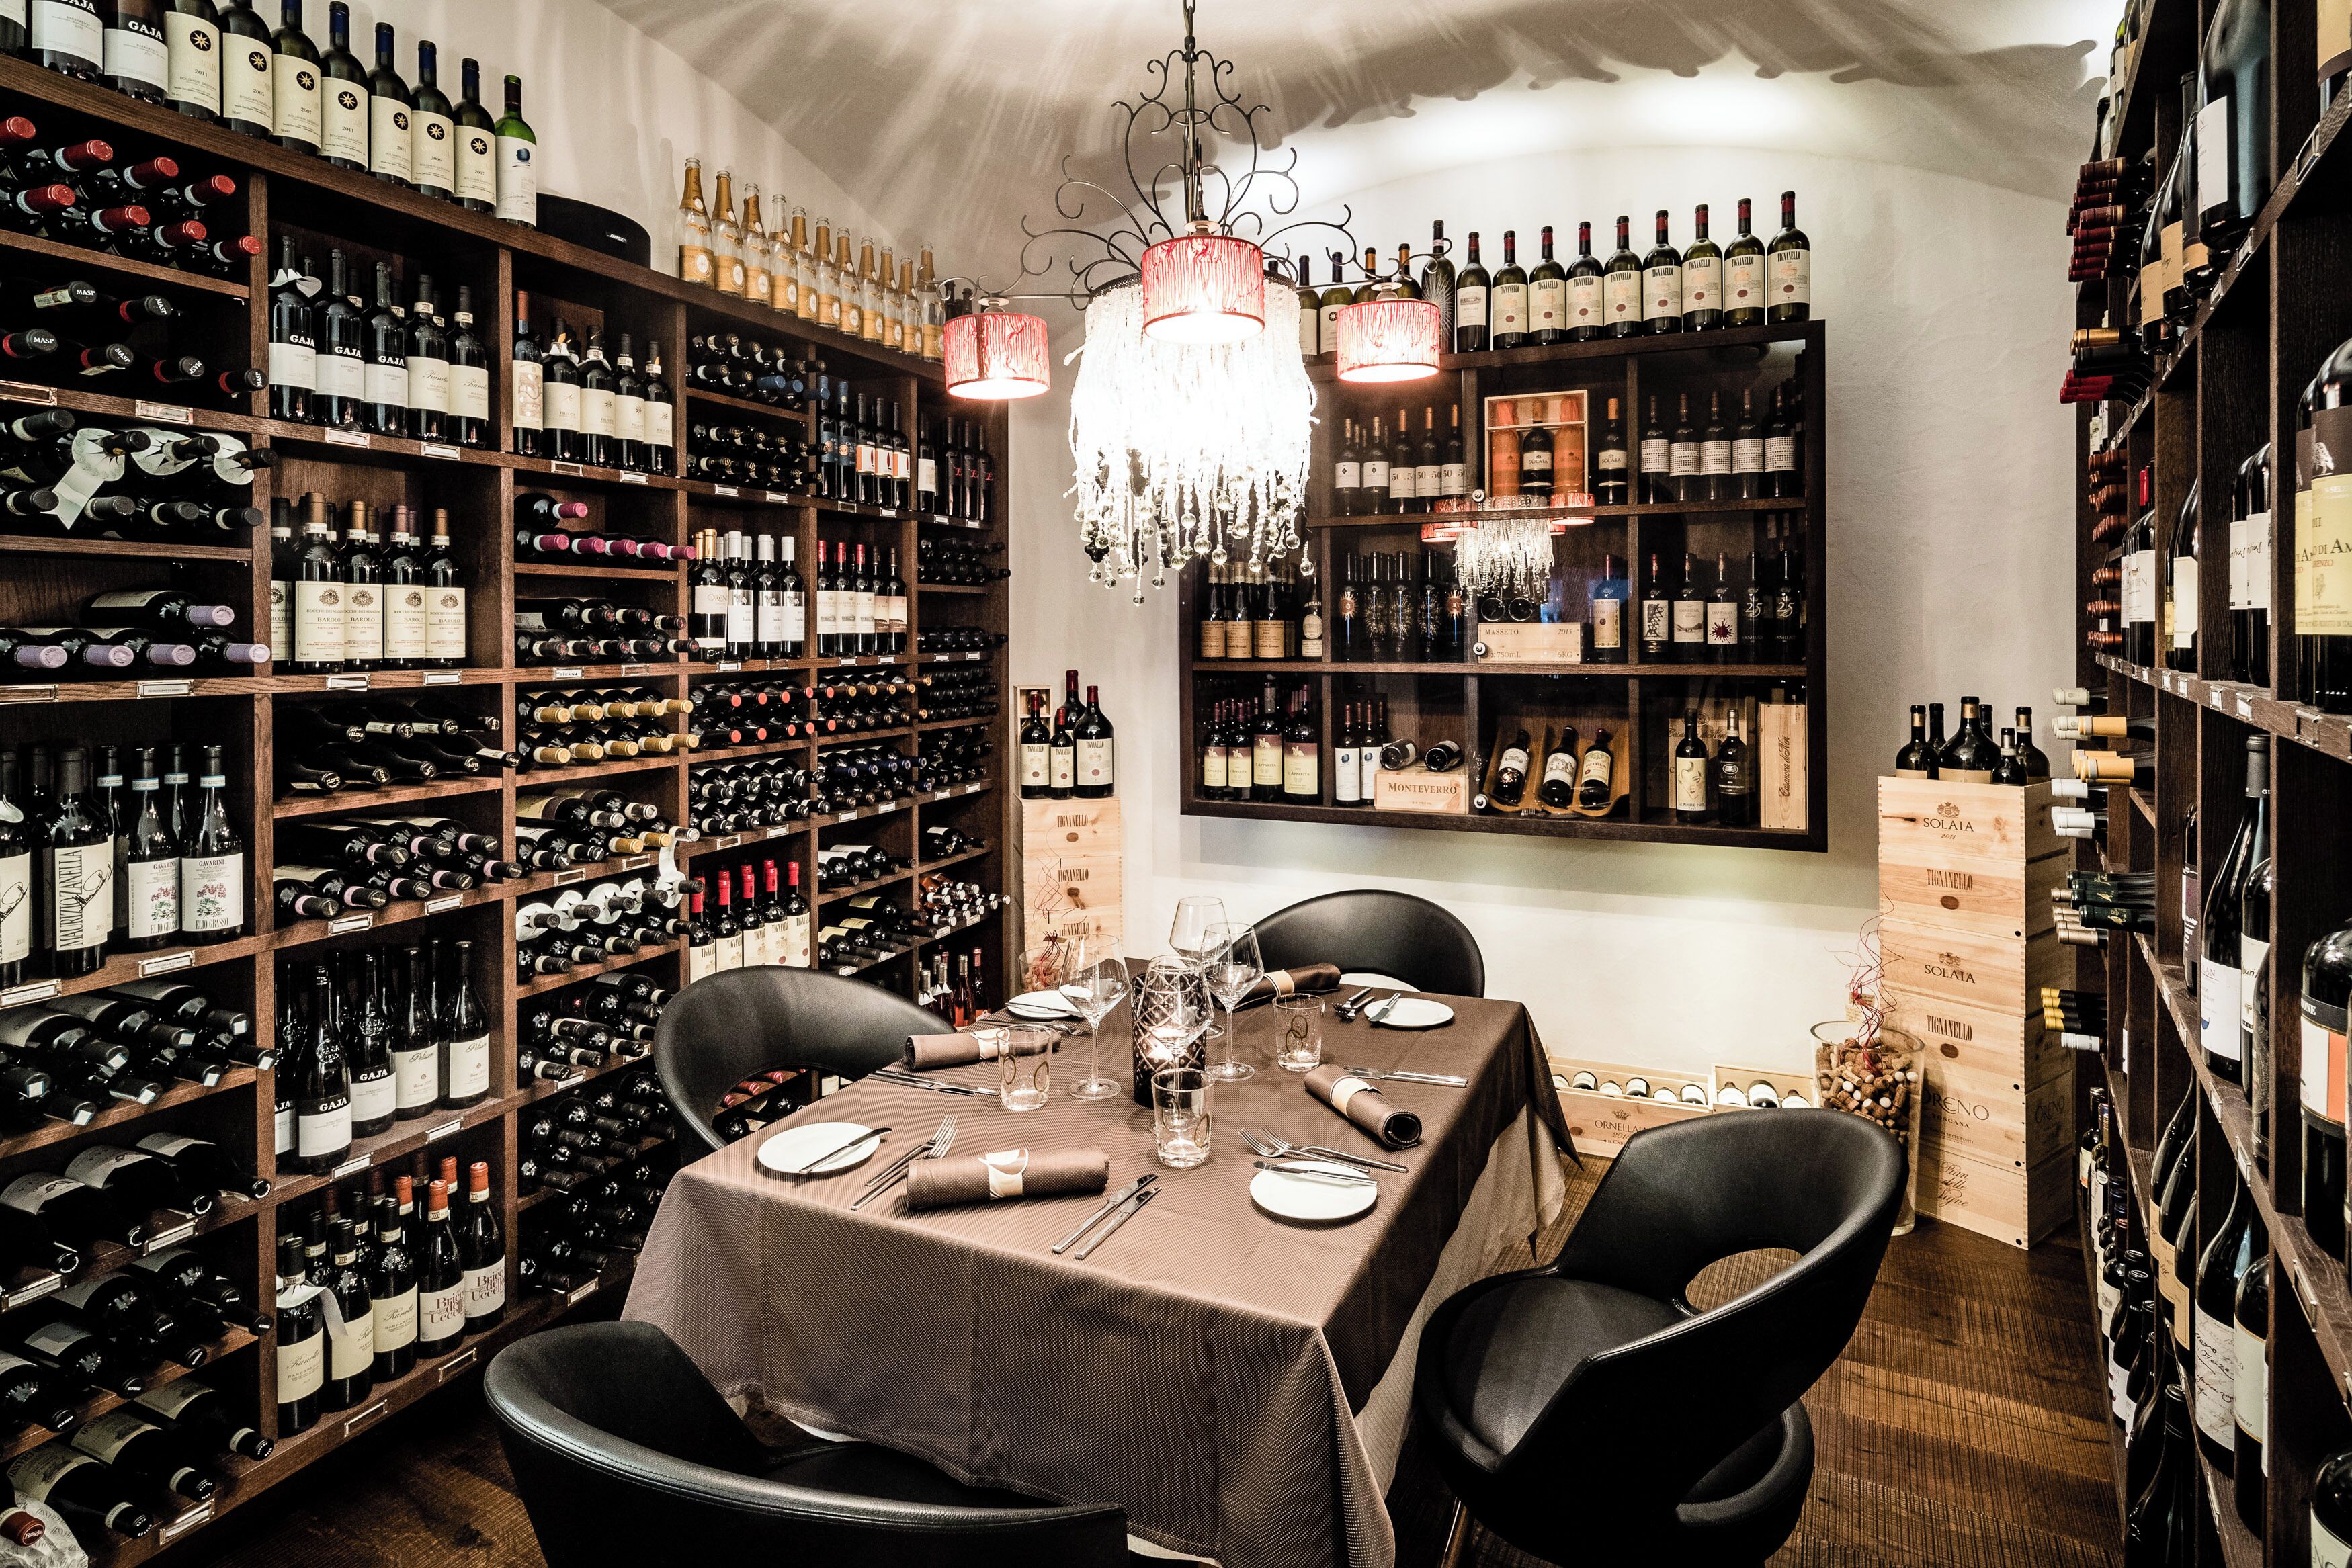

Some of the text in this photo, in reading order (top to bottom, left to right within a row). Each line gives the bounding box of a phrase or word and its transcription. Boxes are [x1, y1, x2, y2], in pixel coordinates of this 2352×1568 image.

[62, 0, 96, 13] AJA
[128, 21, 163, 40] GAJA
[194, 69, 208, 77] 2011
[1732, 257, 1754, 267] TIGNANELLO
[1777, 251, 1801, 262] TIGNANELLO
[1689, 260, 1710, 270] TIGNANELLO
[1611, 273, 1632, 282] TIGNANELLO
[1652, 267, 1673, 277] TIGNANELLO
[1538, 281, 1558, 290] TIGNANELLO
[1574, 277, 1594, 287] TIGNANELLO
[1500, 285, 1520, 294] TIGNANELLO
[290, 335, 315, 347] GAJA
[335, 346, 362, 358] GAJA
[378, 355, 405, 367] GAJA
[1417, 471, 1426, 479] 50
[1443, 470, 1452, 478] 50
[2330, 539, 2352, 554] AM
[1745, 602, 1763, 617] 25
[1777, 601, 1795, 617] 25
[1778, 765, 1790, 798] Casanova
[1388, 782, 1457, 795] MONTEVERRO
[1057, 815, 1088, 828] TIGNANELLO
[1923, 818, 1974, 832] SOLAIA
[199, 859, 225, 867] GAVARINI
[1058, 868, 1089, 882] TIGNANELLO
[1926, 869, 1973, 891] TIGNANELLO
[150, 923, 163, 934] ELIO
[196, 917, 228, 930] ELIO GRASSO
[1925, 964, 1976, 984] SOLAIA
[1927, 1015, 1972, 1042] TIGNANELLO
[360, 1068, 388, 1081] GAJA
[274, 1100, 290, 1113] AJA
[319, 1097, 348, 1112] GAJA
[1923, 1088, 1990, 1121] ORENO
[1932, 1114, 1970, 1129] TOSCANA
[1939, 1158, 1968, 1179] Pian
[1941, 1176, 1967, 1190] delle
[1938, 1188, 1969, 1207] Vigne
